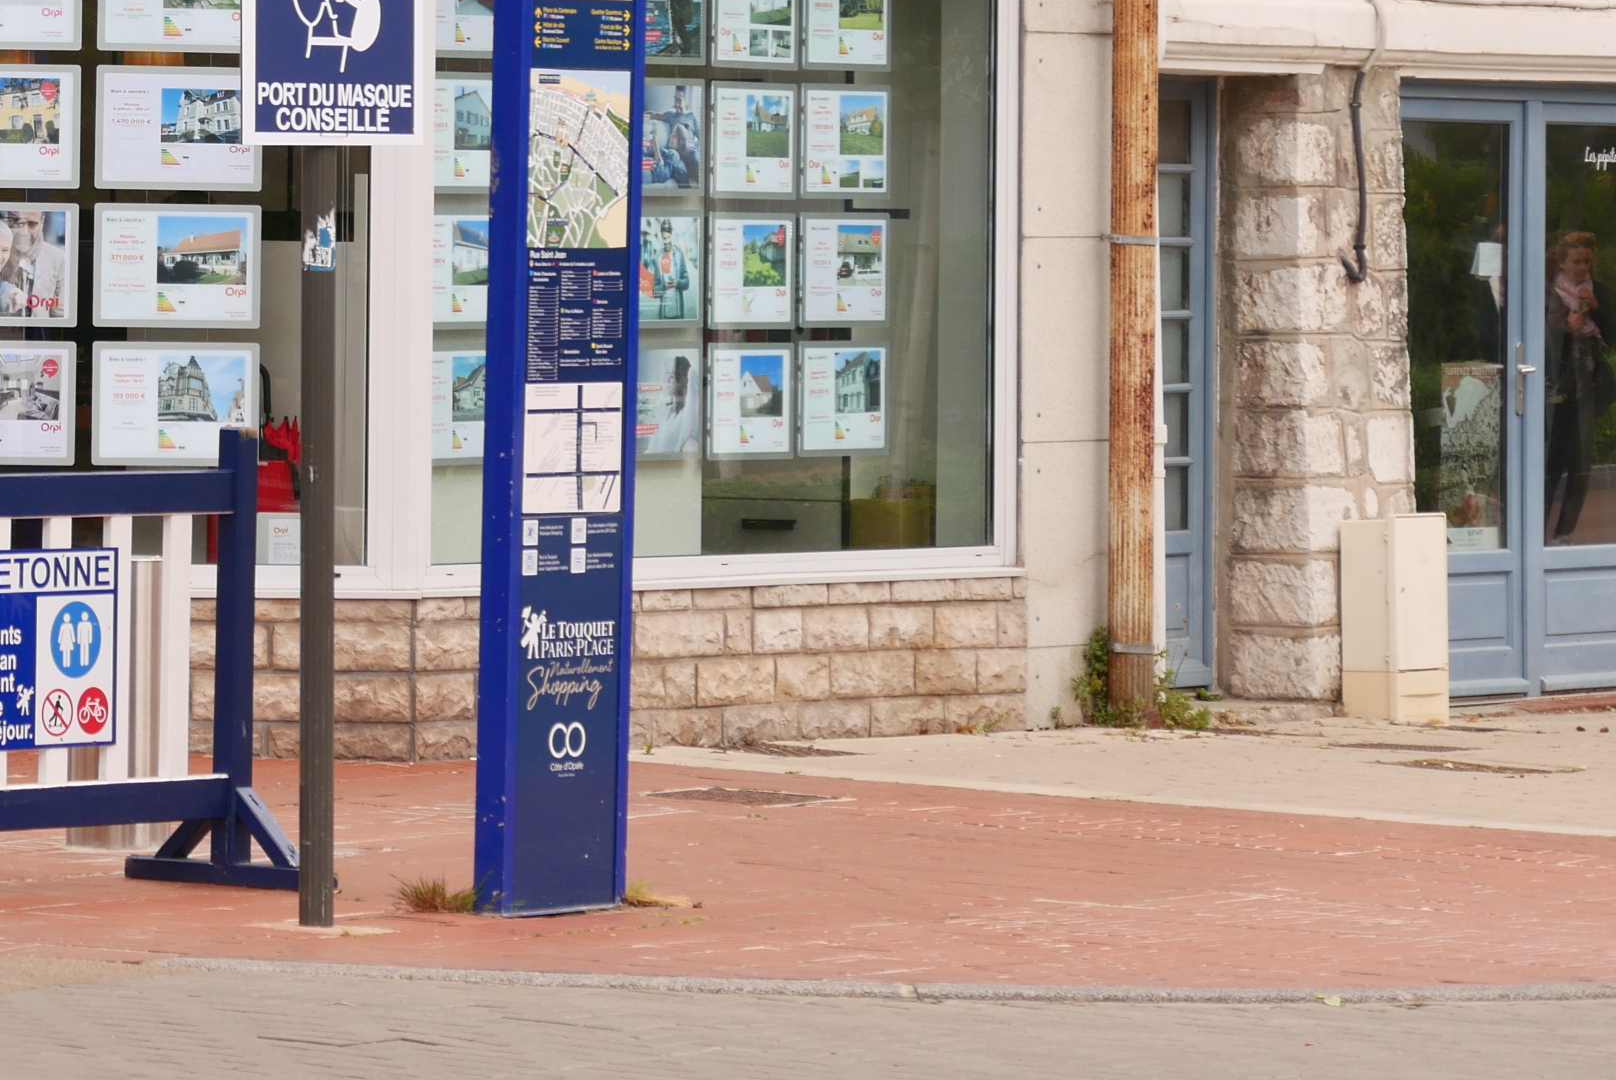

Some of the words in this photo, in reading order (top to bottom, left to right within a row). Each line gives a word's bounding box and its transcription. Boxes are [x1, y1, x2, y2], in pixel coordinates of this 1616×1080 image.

[257, 82, 306, 106] PORT
[309, 83, 334, 106] DU
[338, 84, 412, 110] MASQUE
[275, 106, 390, 132] CONSEILLÉ
[1596, 147, 1616, 171] pépit
[26, 293, 60, 311] Orpi
[557, 621, 615, 642] TOUQUET
[540, 639, 614, 659] PARIS-PLAGE
[549, 659, 614, 678] Naturellement
[526, 666, 603, 711] Shopping
